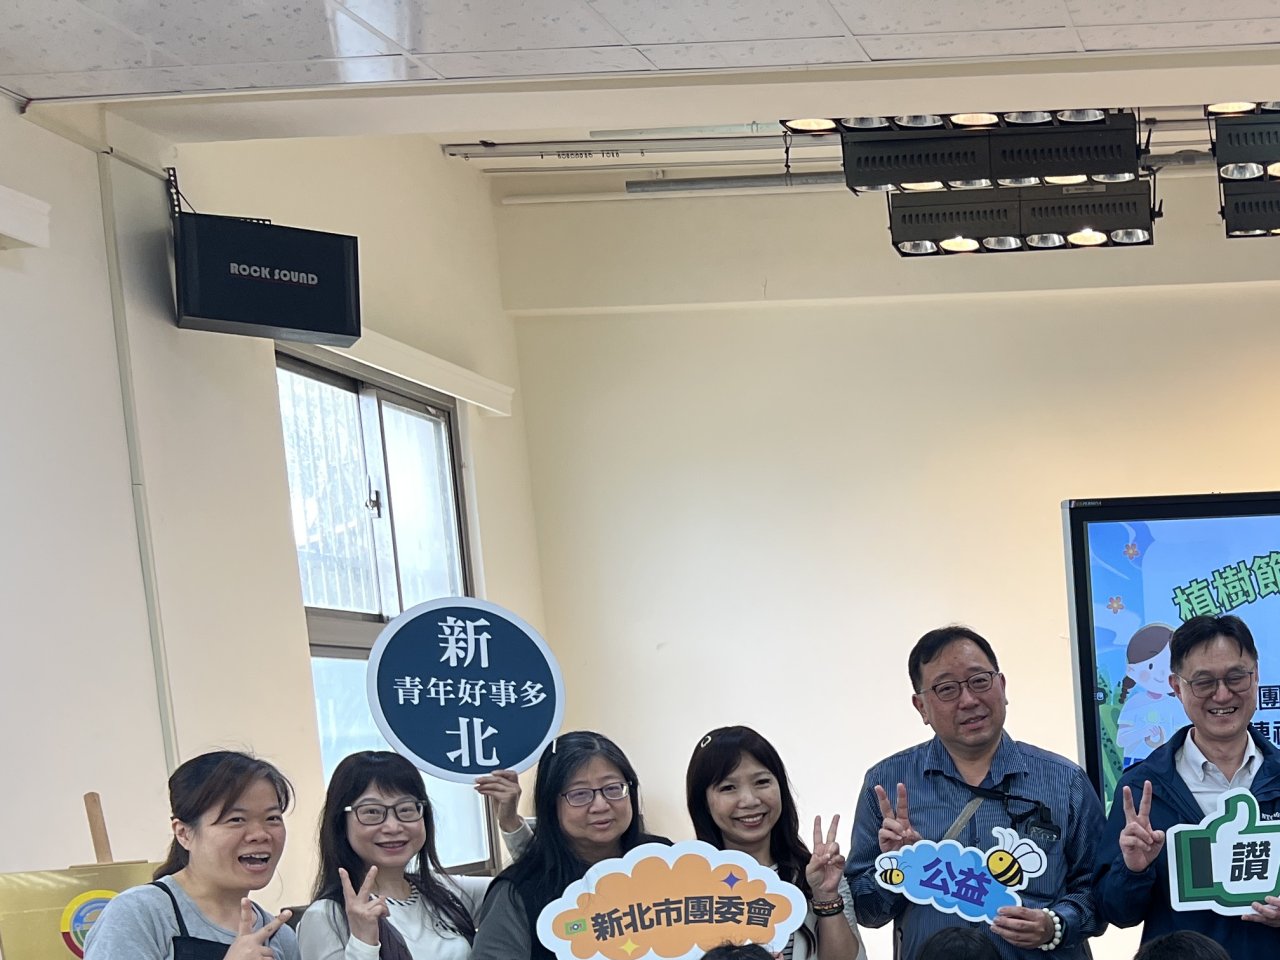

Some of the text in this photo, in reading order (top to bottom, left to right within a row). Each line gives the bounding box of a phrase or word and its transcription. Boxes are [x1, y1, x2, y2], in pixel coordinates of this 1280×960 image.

[229, 262, 319, 285] ROCK SOUND
[437, 615, 492, 669] 新
[393, 676, 547, 708] 青年好事多
[445, 716, 501, 768] 北
[919, 857, 992, 907] 公益
[1229, 840, 1272, 882] 讚
[591, 895, 776, 941] 新北市團委會
